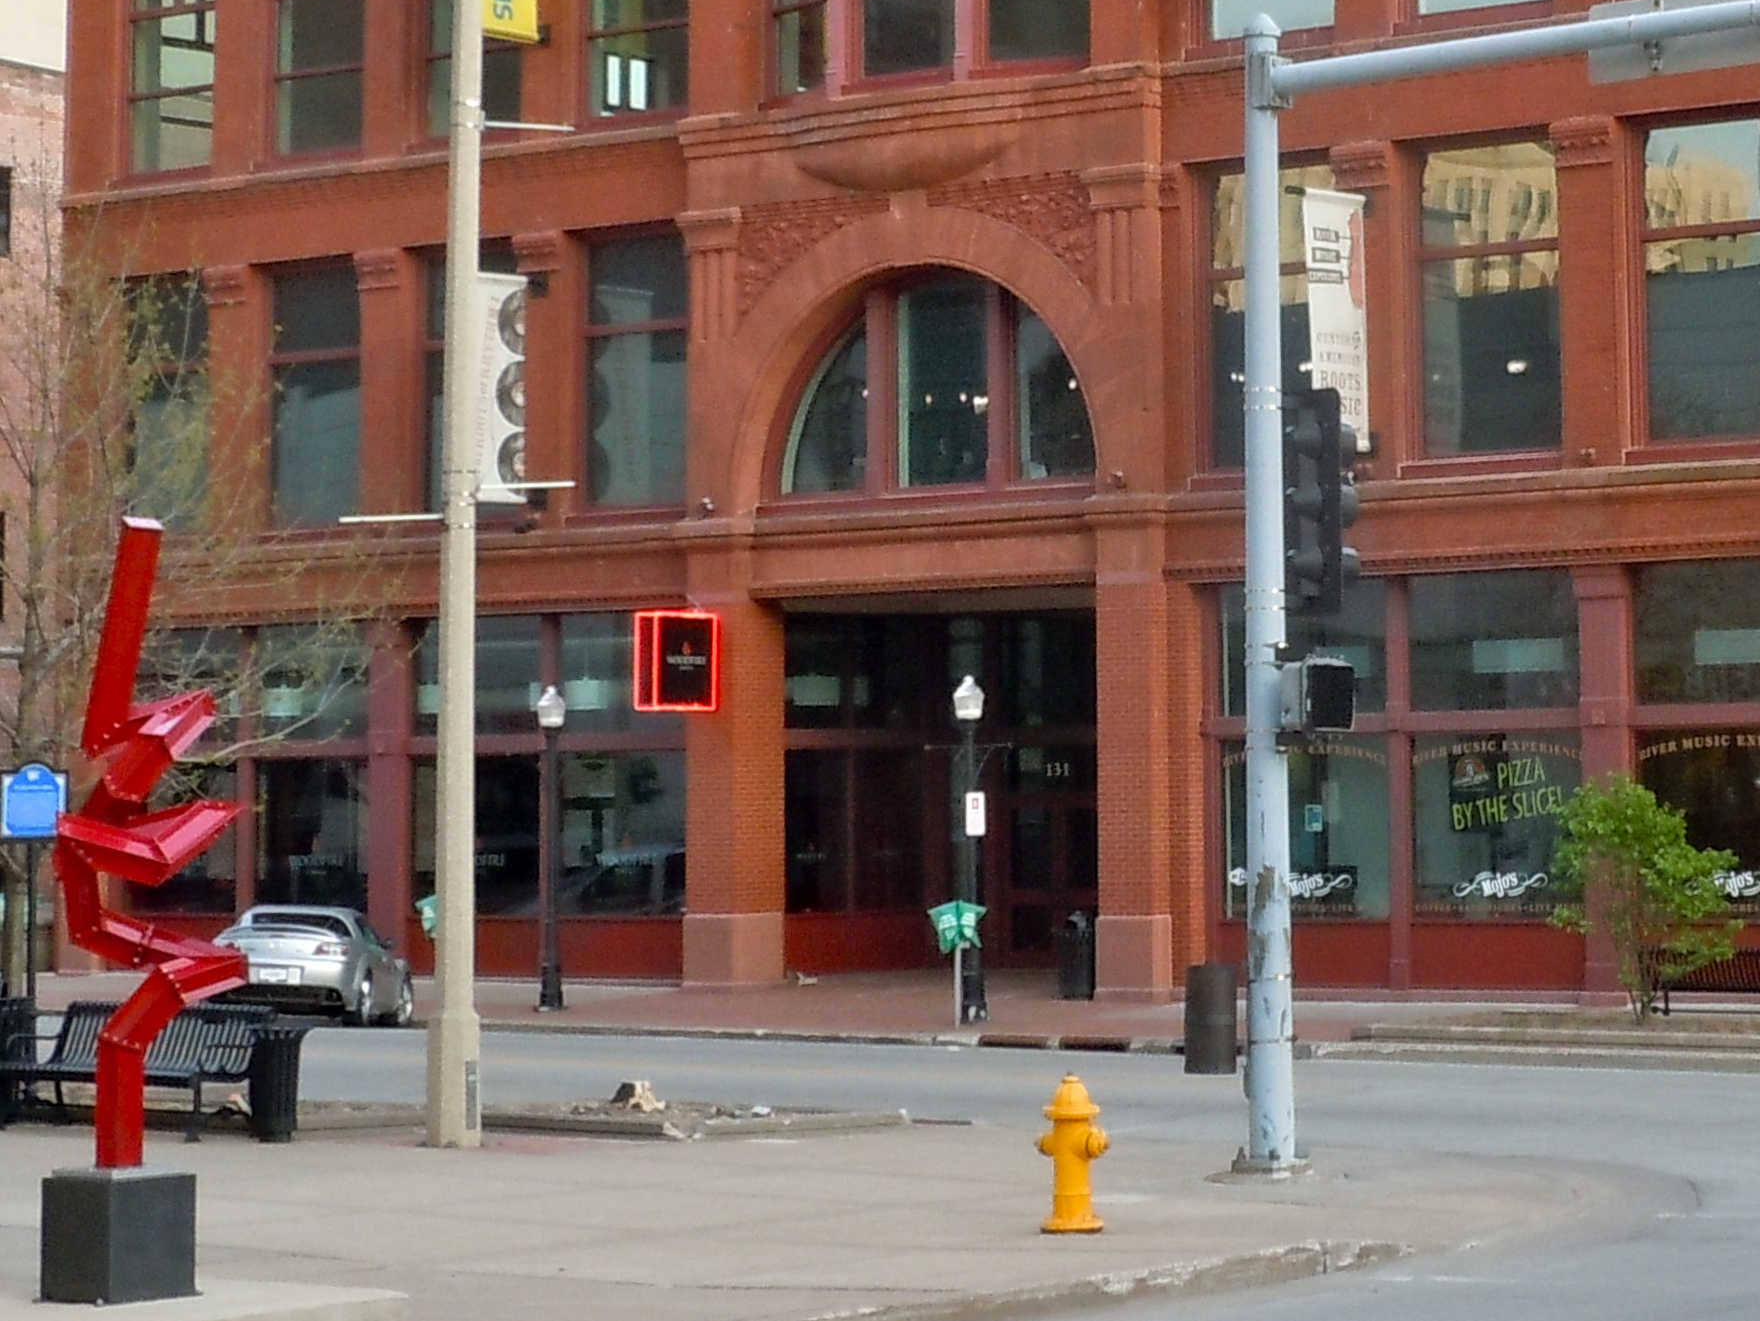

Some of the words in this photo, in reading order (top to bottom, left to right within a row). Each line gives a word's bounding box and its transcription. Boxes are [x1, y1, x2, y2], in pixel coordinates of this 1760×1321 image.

[1320, 370, 1361, 391] ROOTS
[1340, 397, 1362, 416] SIC
[1413, 746, 1447, 765] RIVER
[1452, 741, 1496, 756] MUSIC
[1639, 740, 1678, 761] RIVER
[1682, 734, 1731, 750] MUSIC
[1046, 762, 1070, 777] 131
[1496, 756, 1546, 790] PIZZA
[1452, 801, 1474, 831] BY
[1475, 793, 1509, 827] THE
[1512, 785, 1563, 820] SLICE!
[1288, 872, 1324, 898] Mojo's
[1481, 871, 1519, 898] Mojo's
